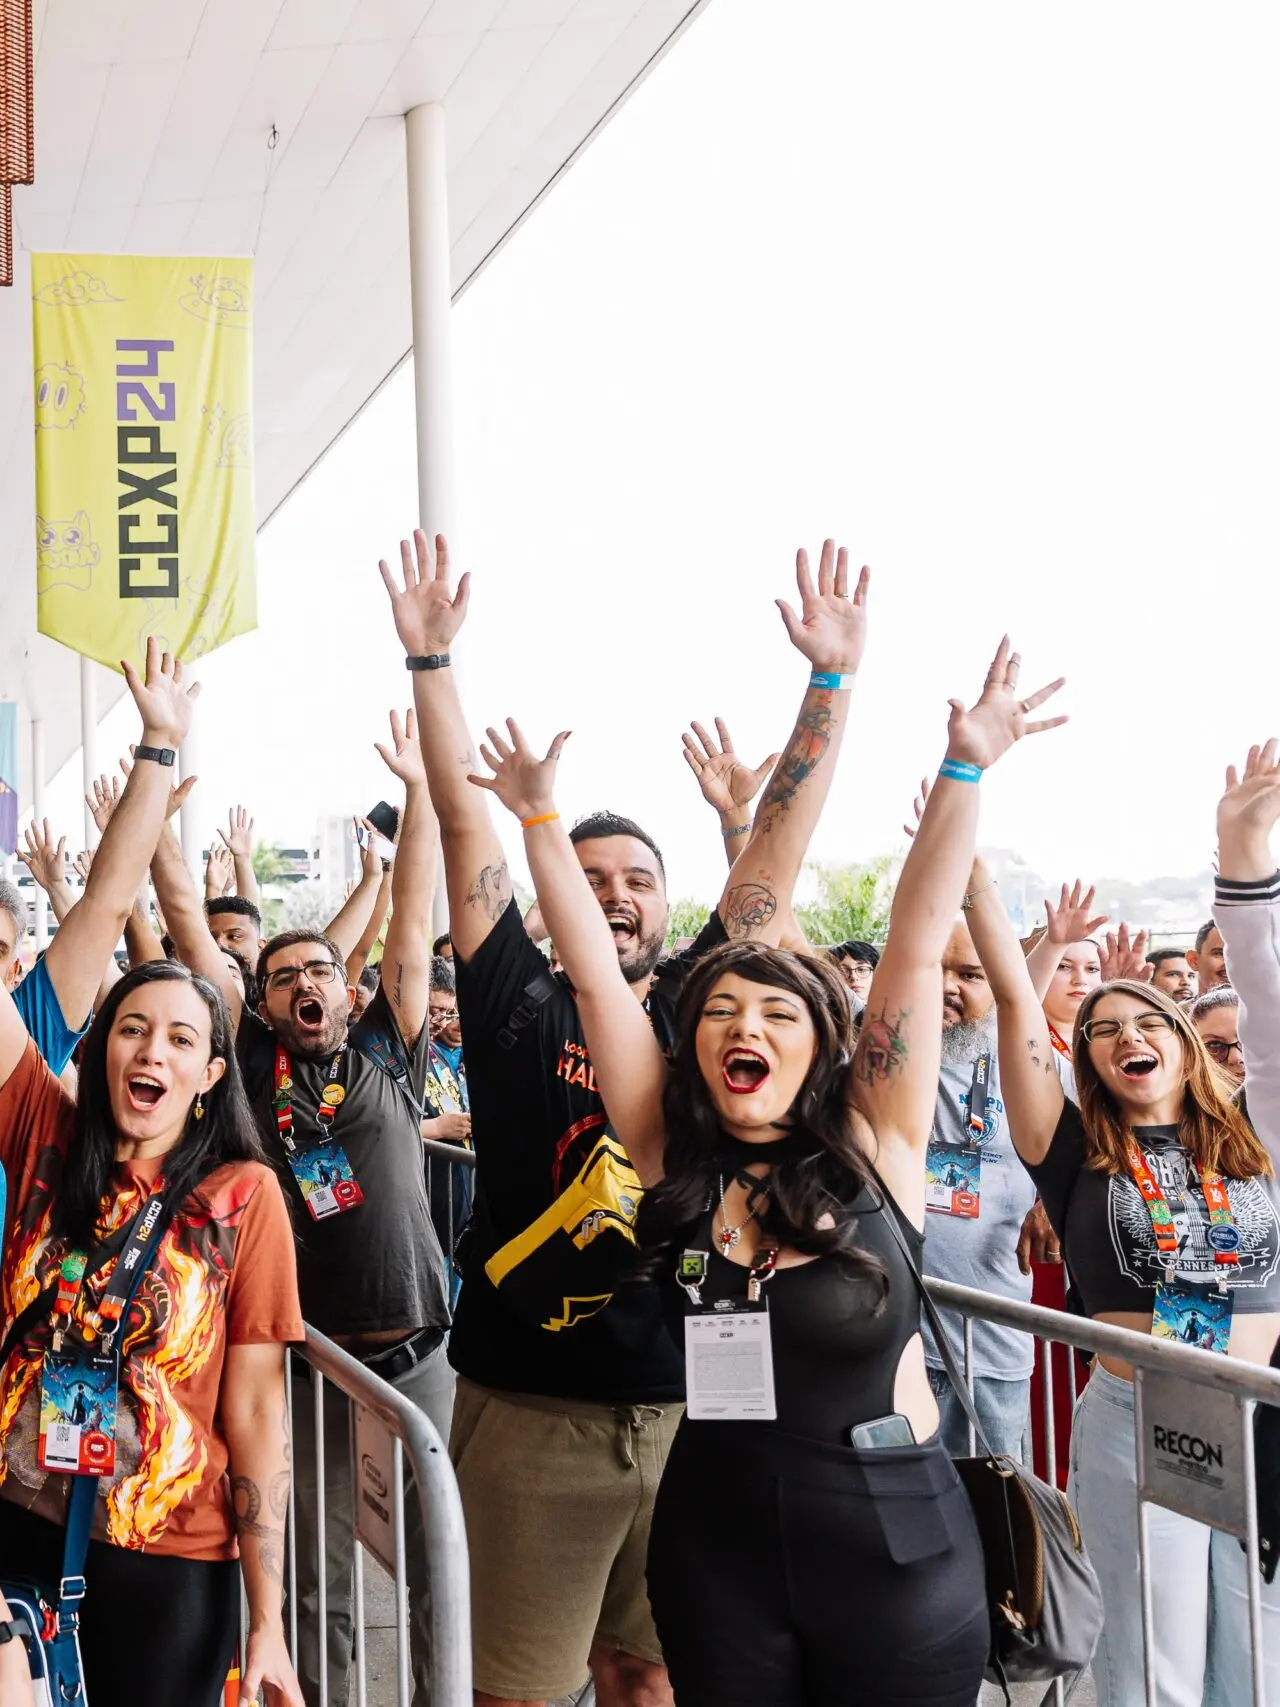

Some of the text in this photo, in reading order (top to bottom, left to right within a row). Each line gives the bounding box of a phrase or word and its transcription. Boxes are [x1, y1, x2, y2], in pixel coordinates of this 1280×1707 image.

[116, 339, 179, 598] CCXP24
[557, 1056, 600, 1091] HAL
[959, 1094, 1003, 1113] NPD
[136, 1200, 163, 1242] CCXP24
[1153, 1425, 1223, 1468] RECON
